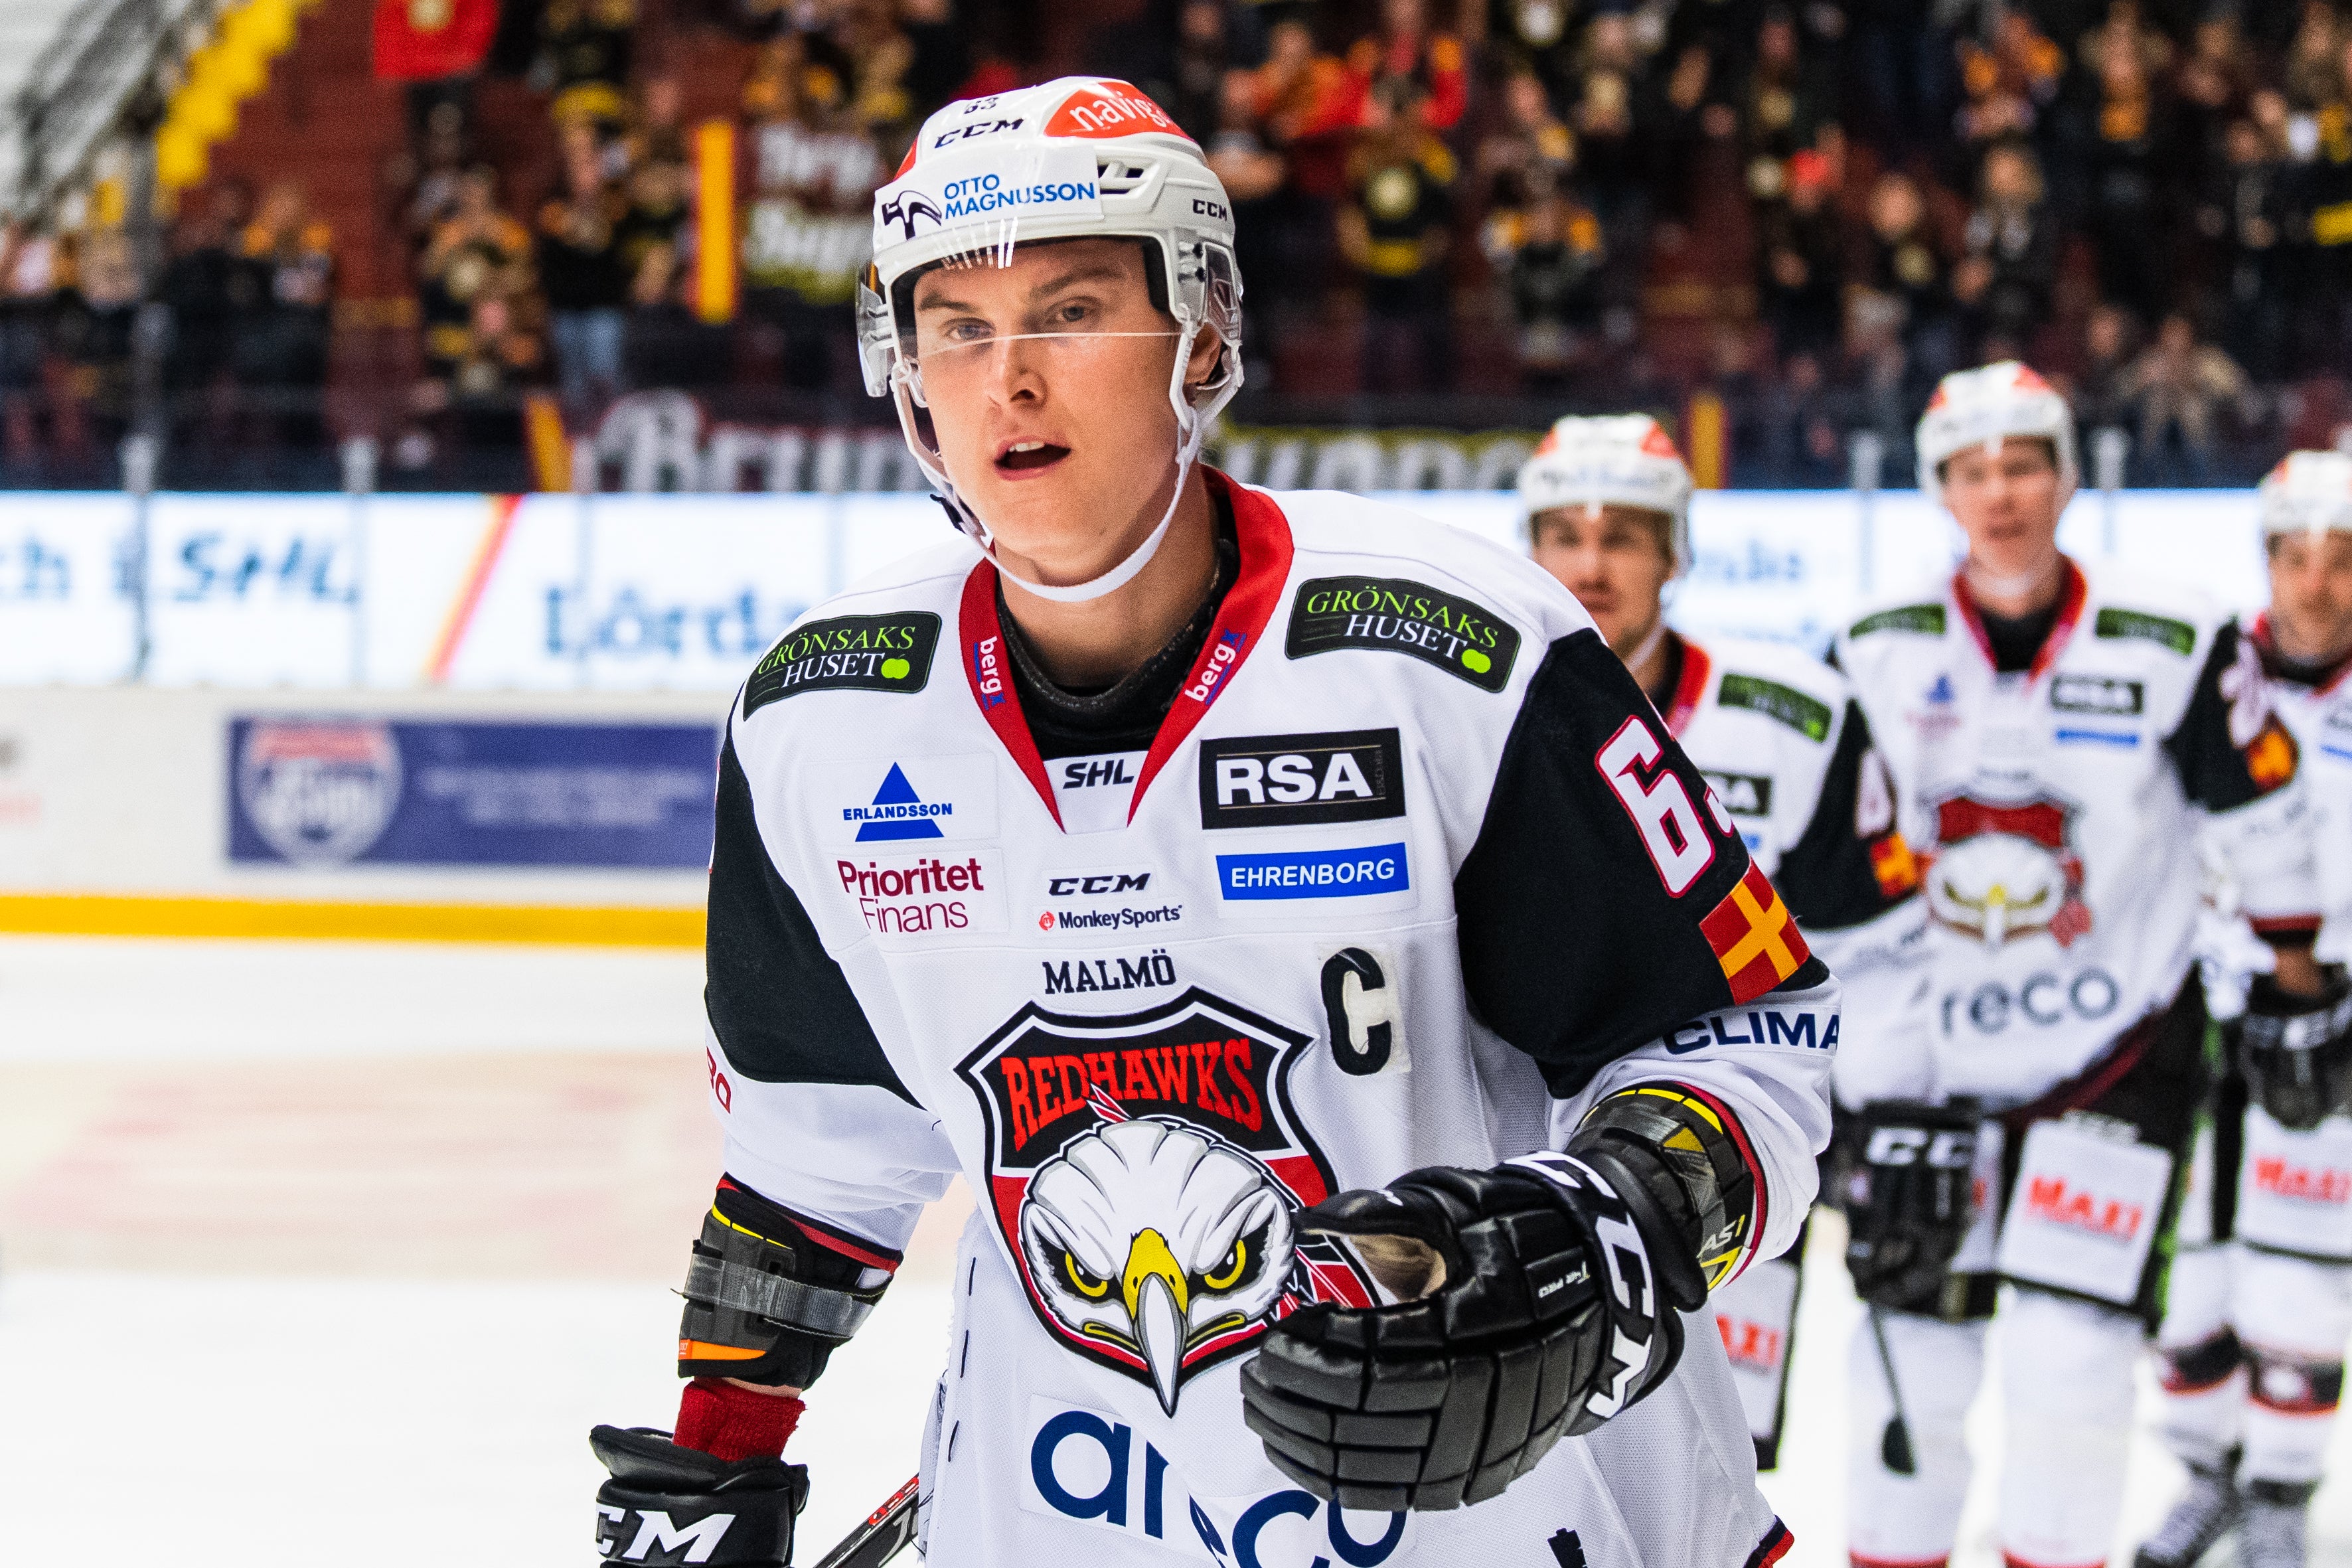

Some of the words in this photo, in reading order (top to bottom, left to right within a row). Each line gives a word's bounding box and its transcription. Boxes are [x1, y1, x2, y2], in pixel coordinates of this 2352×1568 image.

[963, 96, 999, 114] 63
[934, 118, 1026, 149] CCM
[944, 173, 1000, 200] OTTO
[945, 181, 1096, 220] MAGNUSSON
[1193, 198, 1227, 222] CCM
[1306, 585, 1498, 649] GRÖNSAKS
[758, 626, 915, 674] GRÖNSAKS
[1344, 614, 1468, 660] HUSET
[781, 652, 886, 688] HUSET
[1063, 759, 1135, 789] SHL
[1216, 752, 1373, 805] RSA
[843, 803, 953, 821] ERLANDSSON
[1595, 714, 1734, 899] 6
[837, 858, 984, 897] Prioritet
[1048, 872, 1151, 896] CCM
[1231, 858, 1395, 888] EHRENBORG
[859, 897, 969, 933] Finans
[1058, 905, 1181, 930] MonkeySports
[1042, 948, 1177, 994] MALMÖ
[1321, 947, 1392, 1076] C
[1662, 1011, 1840, 1056] CLIMA
[1000, 1038, 1262, 1152] REDHAWKS
